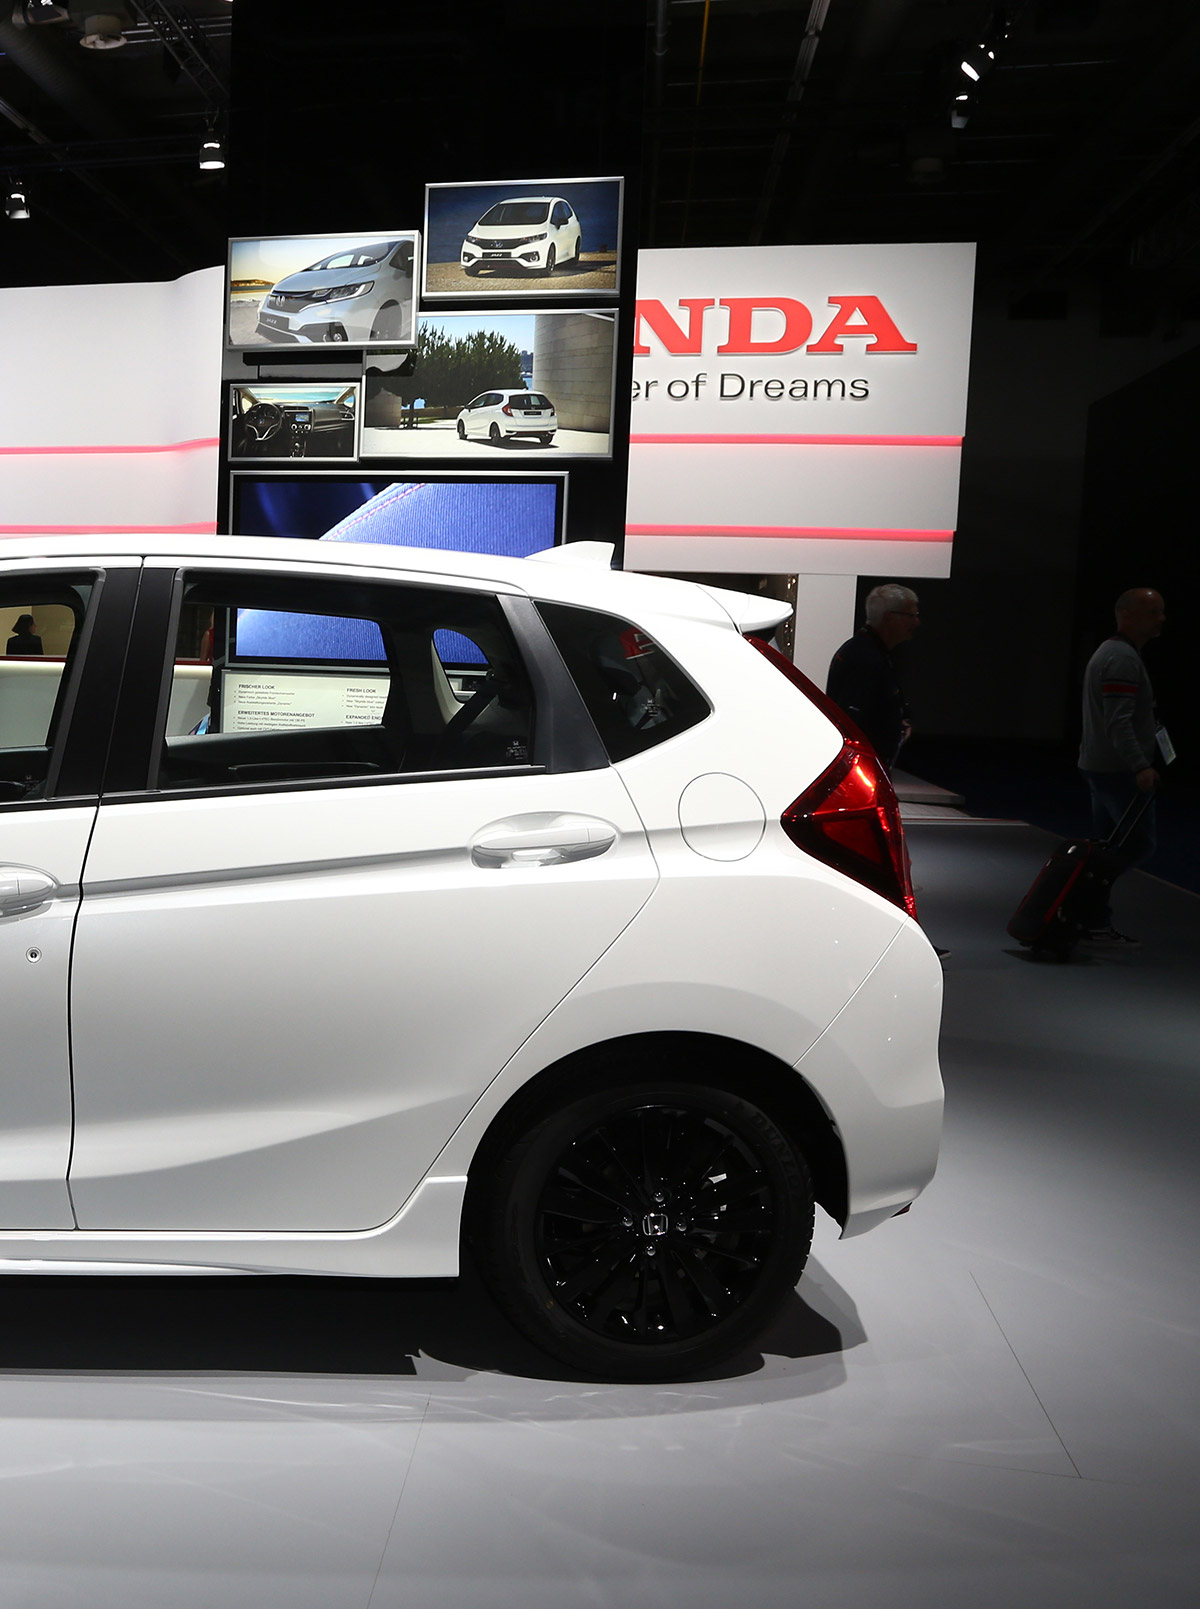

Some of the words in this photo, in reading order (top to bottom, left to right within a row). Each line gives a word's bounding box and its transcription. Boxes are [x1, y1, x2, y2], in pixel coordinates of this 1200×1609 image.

[633, 295, 918, 355] NDA
[667, 372, 707, 399] of
[720, 373, 870, 400] Dreams
